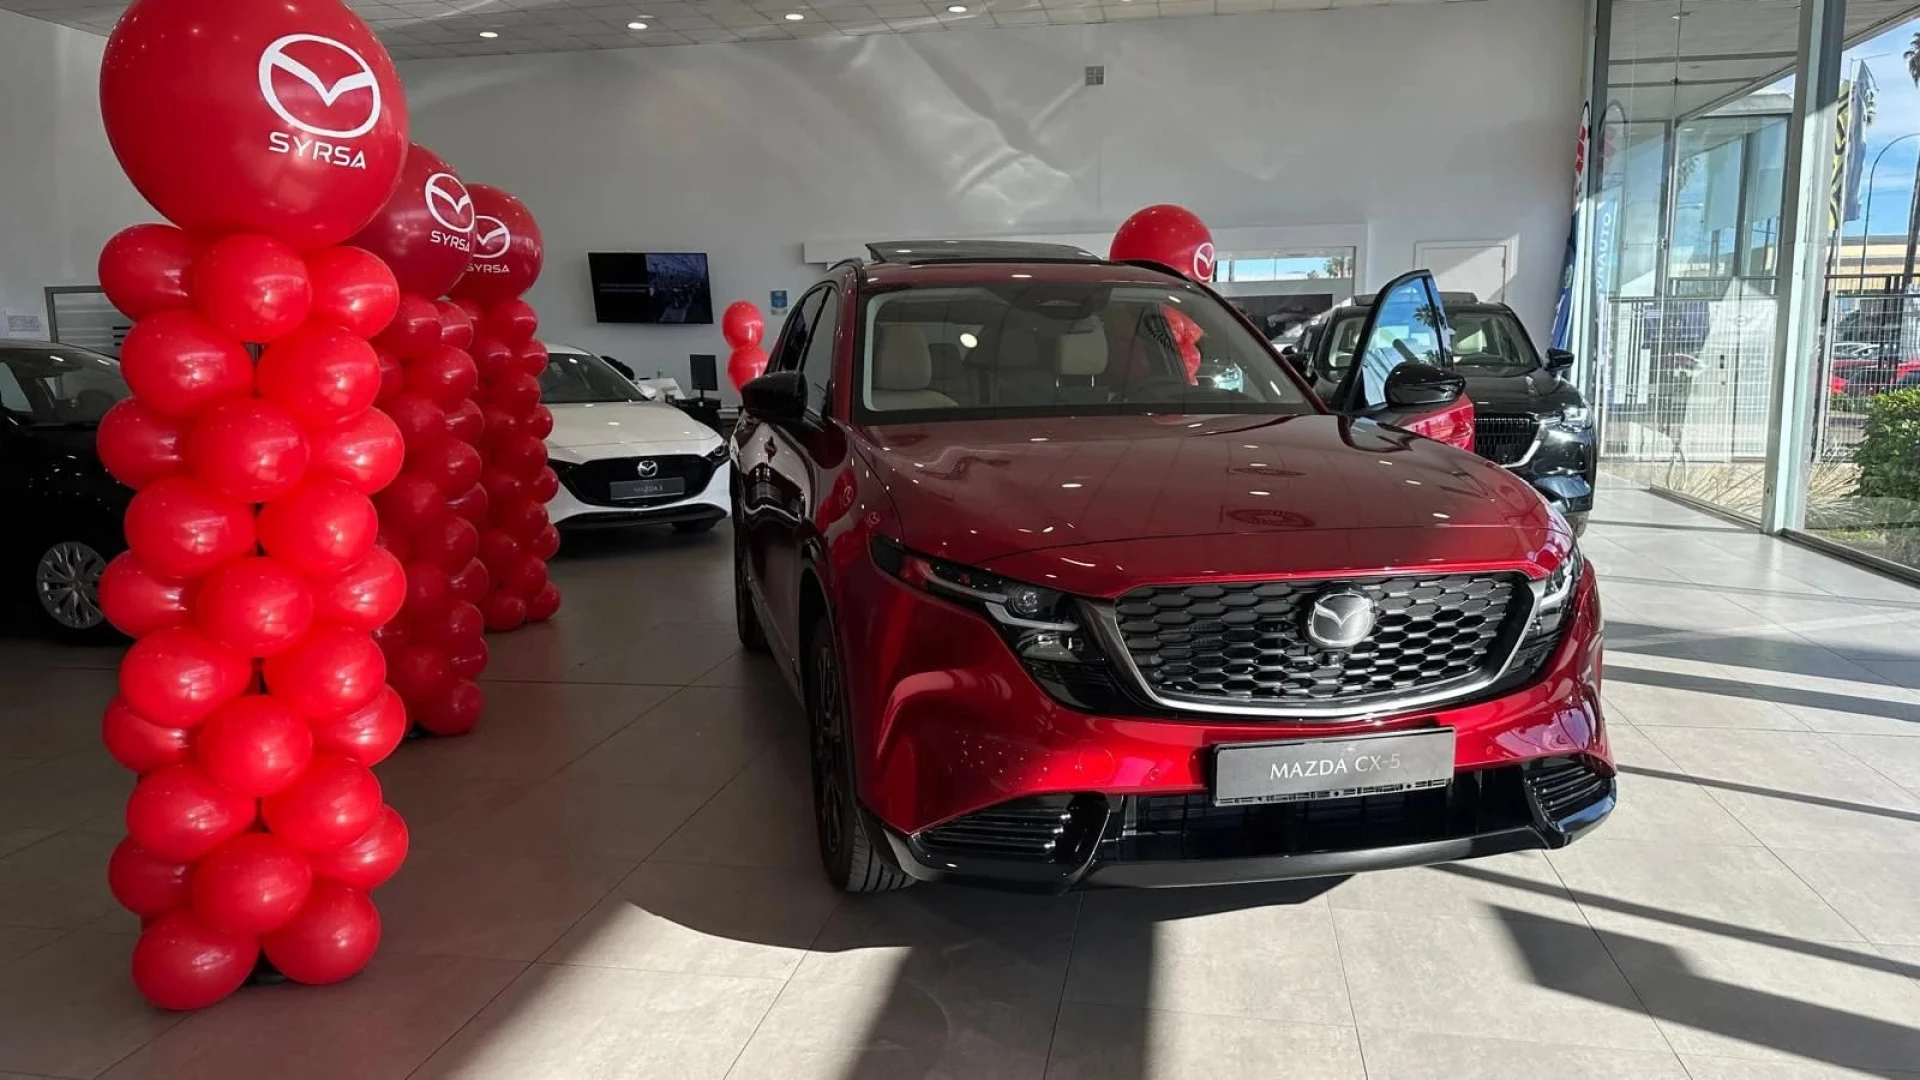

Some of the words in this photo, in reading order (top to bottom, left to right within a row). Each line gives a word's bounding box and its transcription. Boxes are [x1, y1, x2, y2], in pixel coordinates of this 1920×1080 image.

[268, 131, 367, 170] SYRSA
[1270, 758, 1348, 780] MAZDA
[1354, 753, 1401, 773] CX-5
